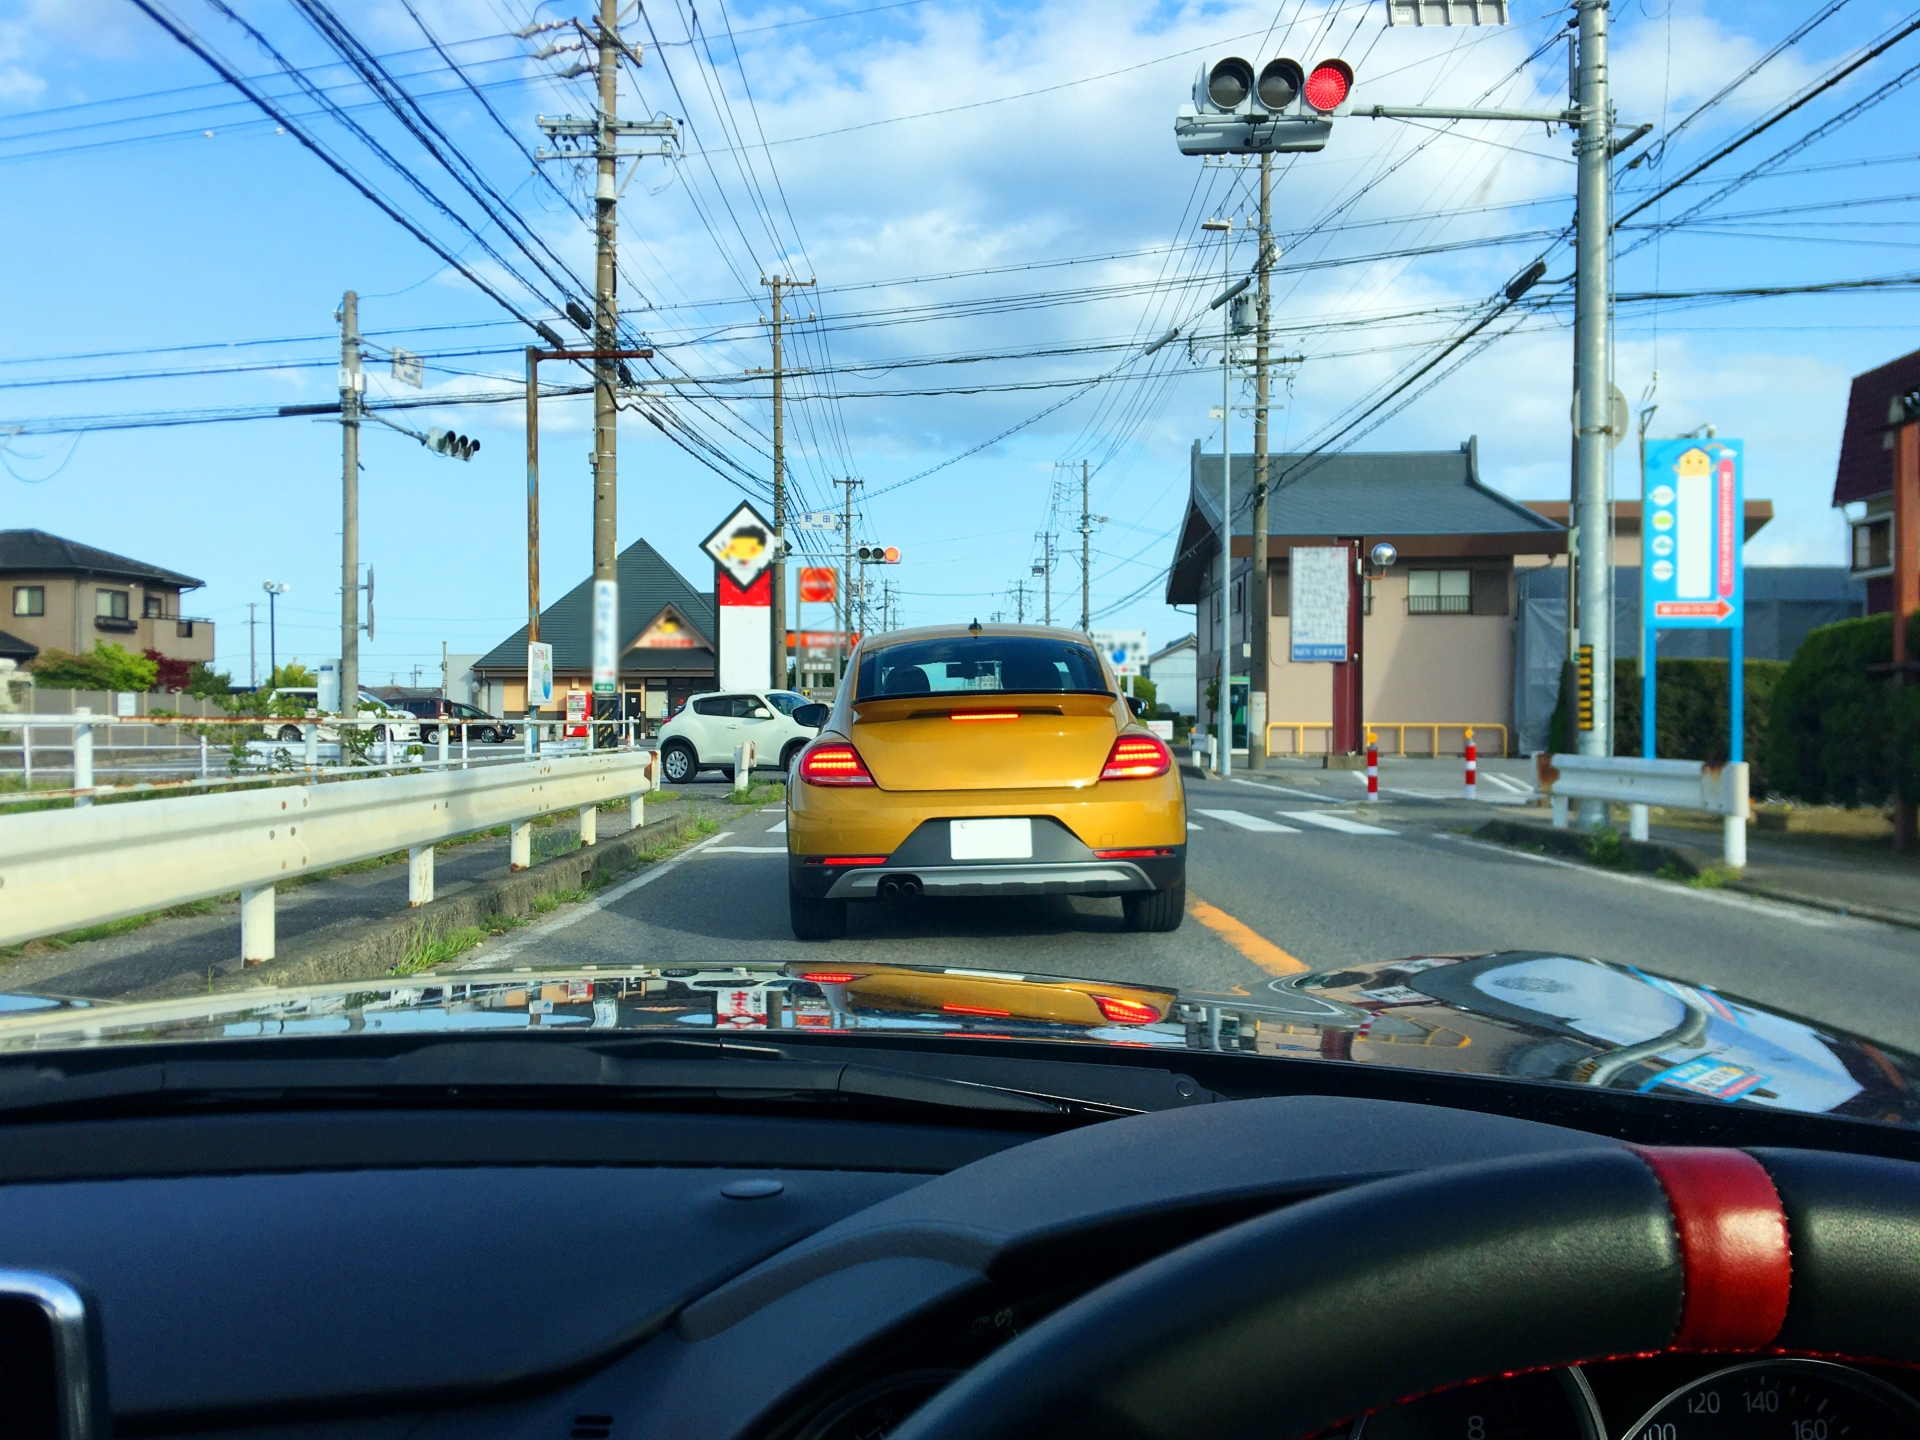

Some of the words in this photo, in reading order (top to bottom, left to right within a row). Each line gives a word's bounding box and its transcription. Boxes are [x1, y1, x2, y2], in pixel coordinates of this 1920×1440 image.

[804, 514, 830, 522] 野田
[1688, 1391, 1721, 1414] 120
[1742, 1390, 1779, 1413] 140
[1467, 1415, 1486, 1440] 8
[1791, 1418, 1828, 1440] 160
